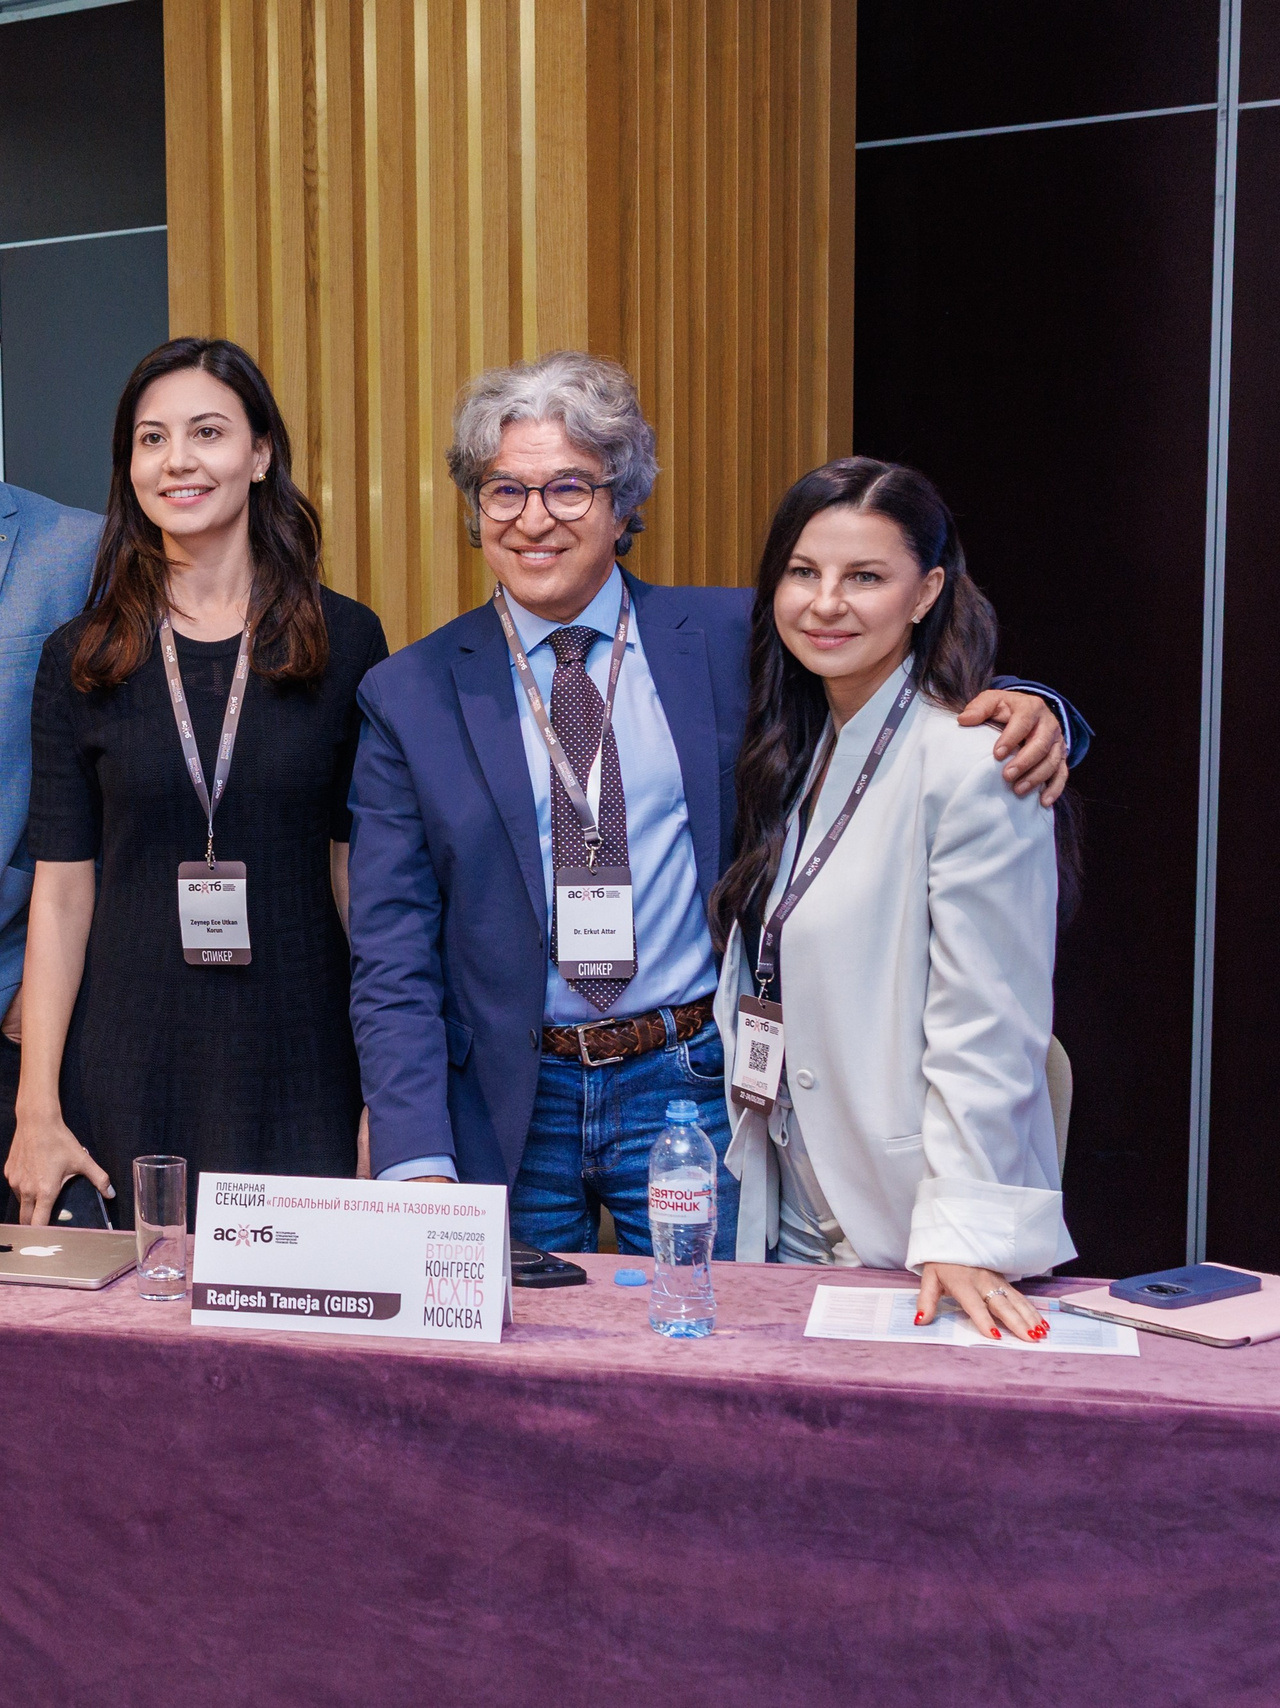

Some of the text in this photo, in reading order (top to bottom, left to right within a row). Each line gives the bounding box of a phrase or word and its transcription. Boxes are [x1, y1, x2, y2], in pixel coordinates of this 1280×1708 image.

[201, 950, 233, 962] СПИКЕР
[578, 962, 613, 975] СПИКЕР
[216, 1182, 266, 1193] ПЛЕНАРНАЯ
[215, 1192, 487, 1217] СЕКЦИЯ «ГЛОБАЛЬНЫЙ ВЗГЛЯД НА ТАЗОВУЮ БОЛЬ»
[650, 1198, 700, 1211] СТОЧНИК
[427, 1230, 485, 1242] 22-24/05/2026
[425, 1243, 485, 1261] ВТОРОЙ
[425, 1260, 485, 1280] КОНГРЕСС
[424, 1277, 484, 1307] АСХТБ
[206, 1289, 374, 1318] Radjesh Taneja (GIBS)
[423, 1306, 483, 1330] МОСКВА
